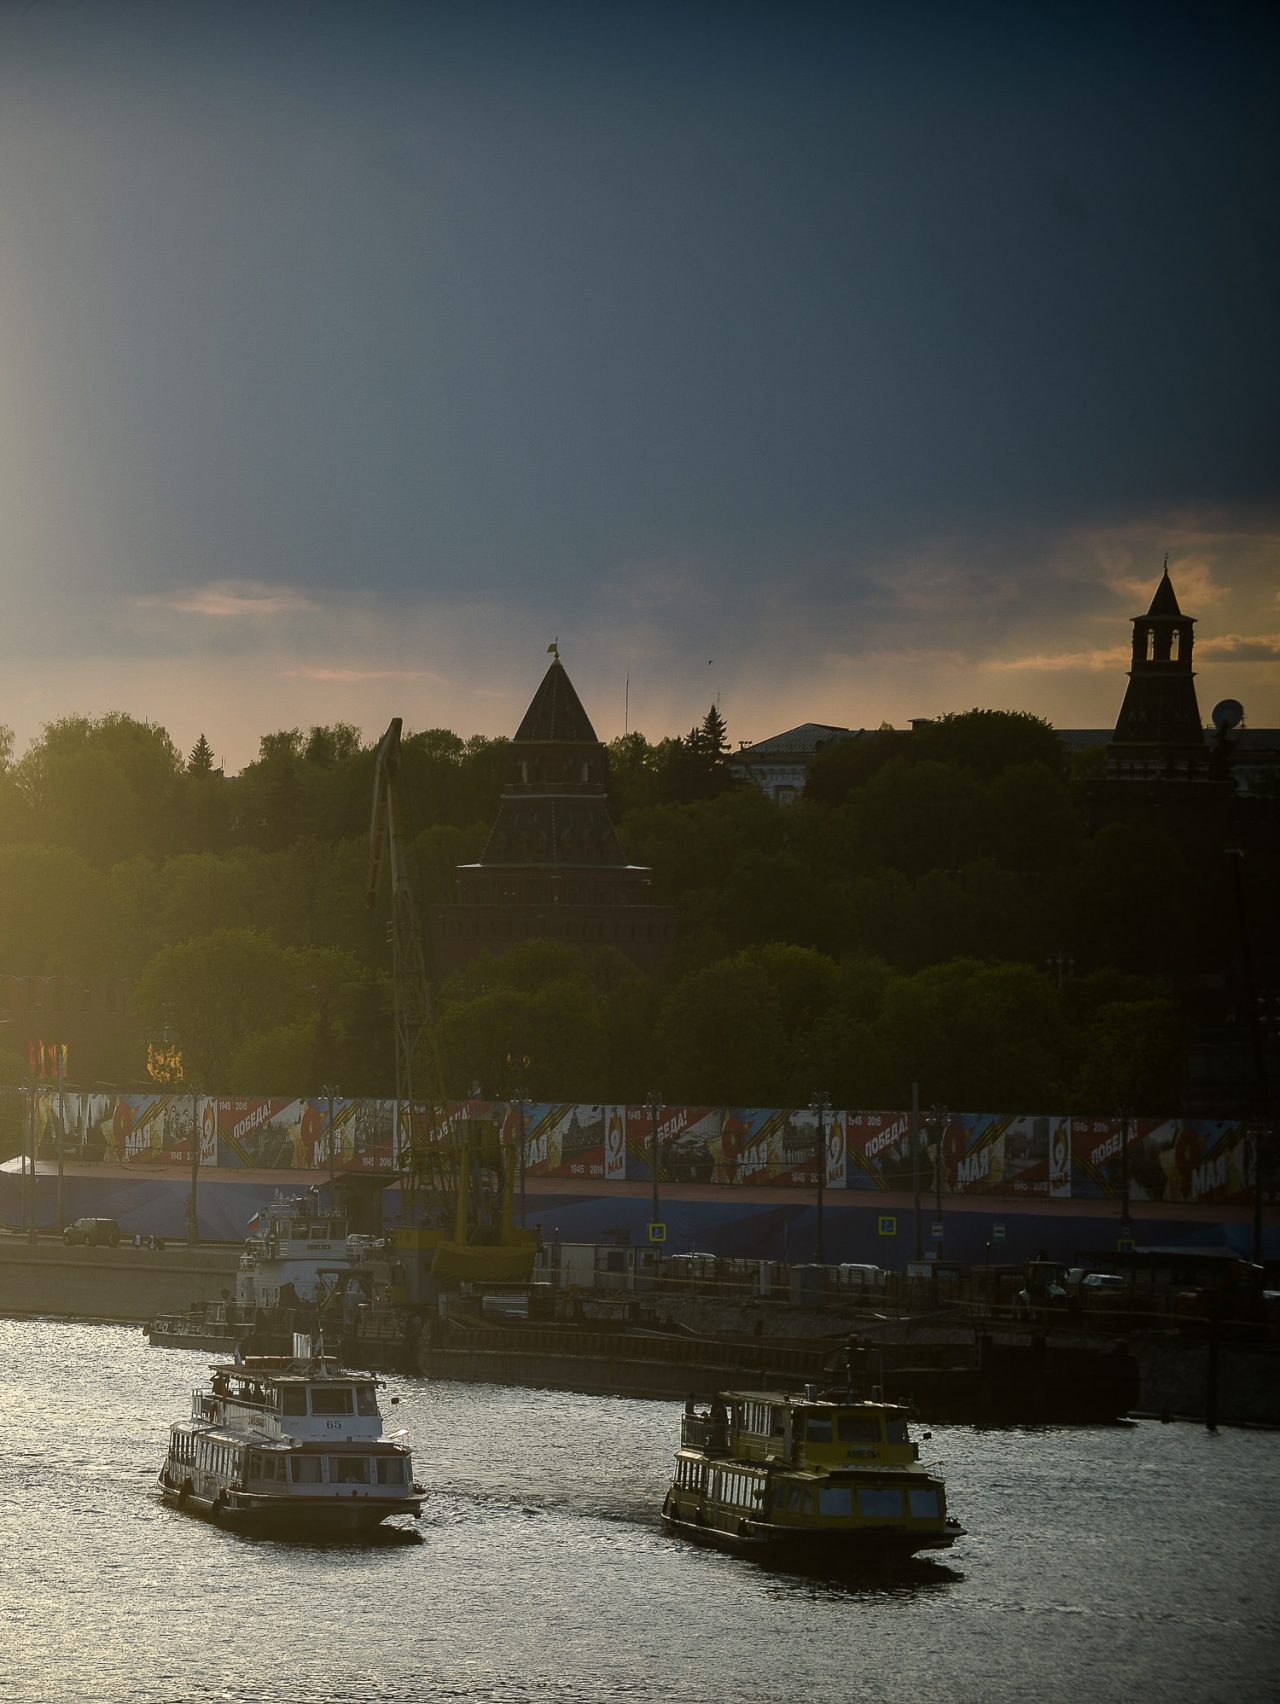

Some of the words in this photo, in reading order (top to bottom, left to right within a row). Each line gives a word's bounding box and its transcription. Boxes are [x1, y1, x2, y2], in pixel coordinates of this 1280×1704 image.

[219, 1102, 231, 1110] 1945
[233, 1100, 271, 1138] ПОБЕДА!
[865, 1114, 908, 1157] ПОБЕДА!
[571, 1164, 584, 1174] 1945
[736, 1140, 768, 1181] МАЯ
[958, 1145, 990, 1183] МАЯ
[326, 1420, 341, 1429] 65
